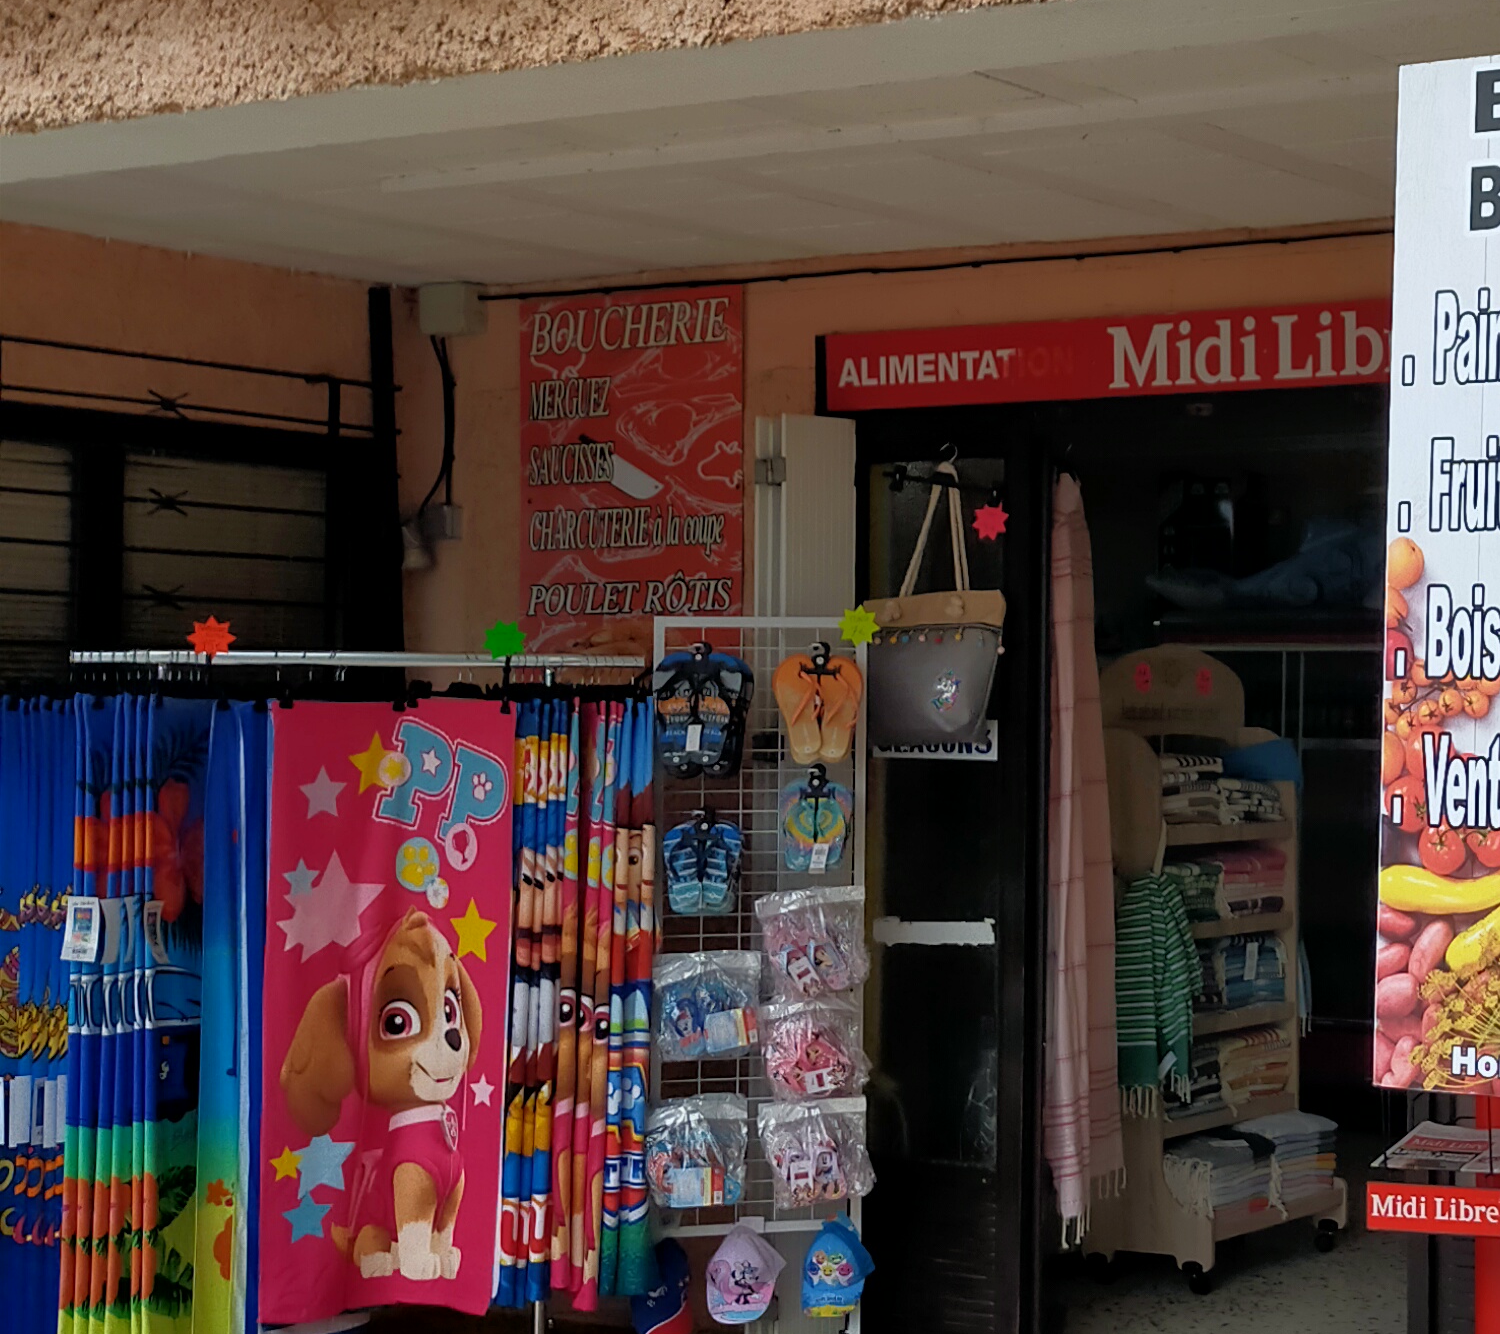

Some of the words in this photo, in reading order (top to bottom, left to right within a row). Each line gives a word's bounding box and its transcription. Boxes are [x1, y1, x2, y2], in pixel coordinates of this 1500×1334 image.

[529, 296, 729, 358] BOUCHERIE
[1106, 315, 1258, 390] Midi
[528, 375, 612, 421] MERGUEZ
[528, 441, 614, 488] SAUCISSES
[528, 505, 651, 552] CHARCUTERIE
[652, 517, 662, 547] à
[666, 509, 679, 547] la
[683, 512, 725, 556] coupe
[527, 582, 639, 618] POULET
[643, 570, 733, 613] RÔTIS
[1370, 1194, 1427, 1219] Midi
[1434, 1197, 1499, 1224] Libre
